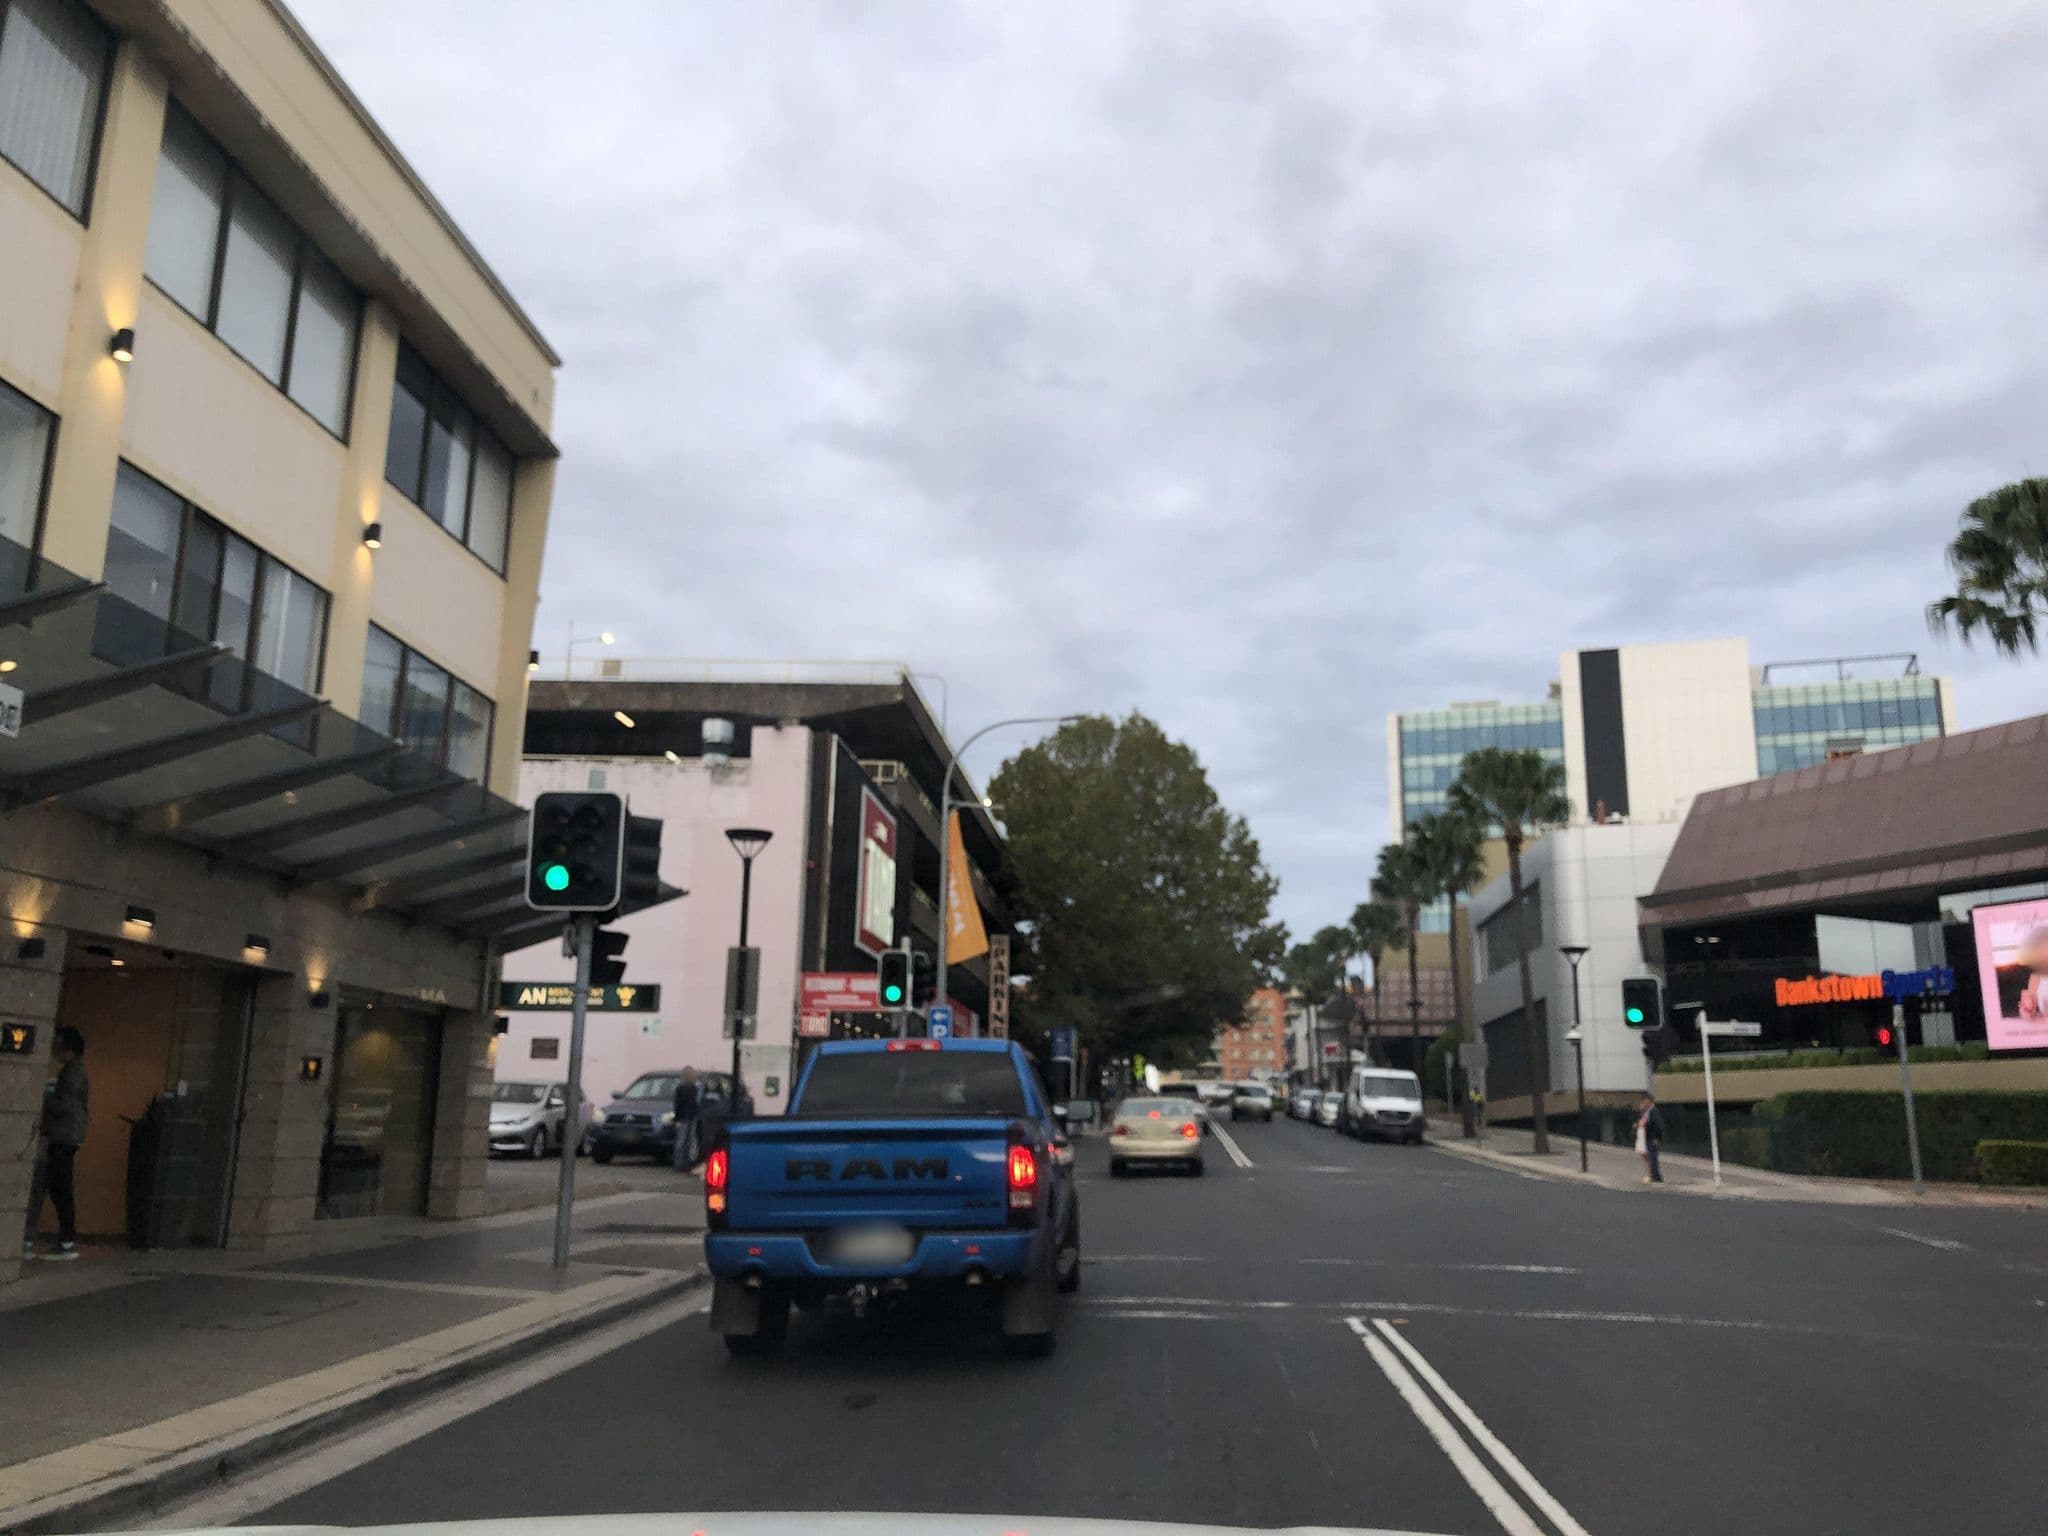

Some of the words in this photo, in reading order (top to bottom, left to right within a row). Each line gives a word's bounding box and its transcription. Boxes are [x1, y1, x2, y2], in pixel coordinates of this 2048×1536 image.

[518, 986, 547, 1005] AN
[992, 946, 1006, 1038] PARKING
[1775, 975, 1883, 1007] Bankstown
[785, 1157, 948, 1181] RAM
